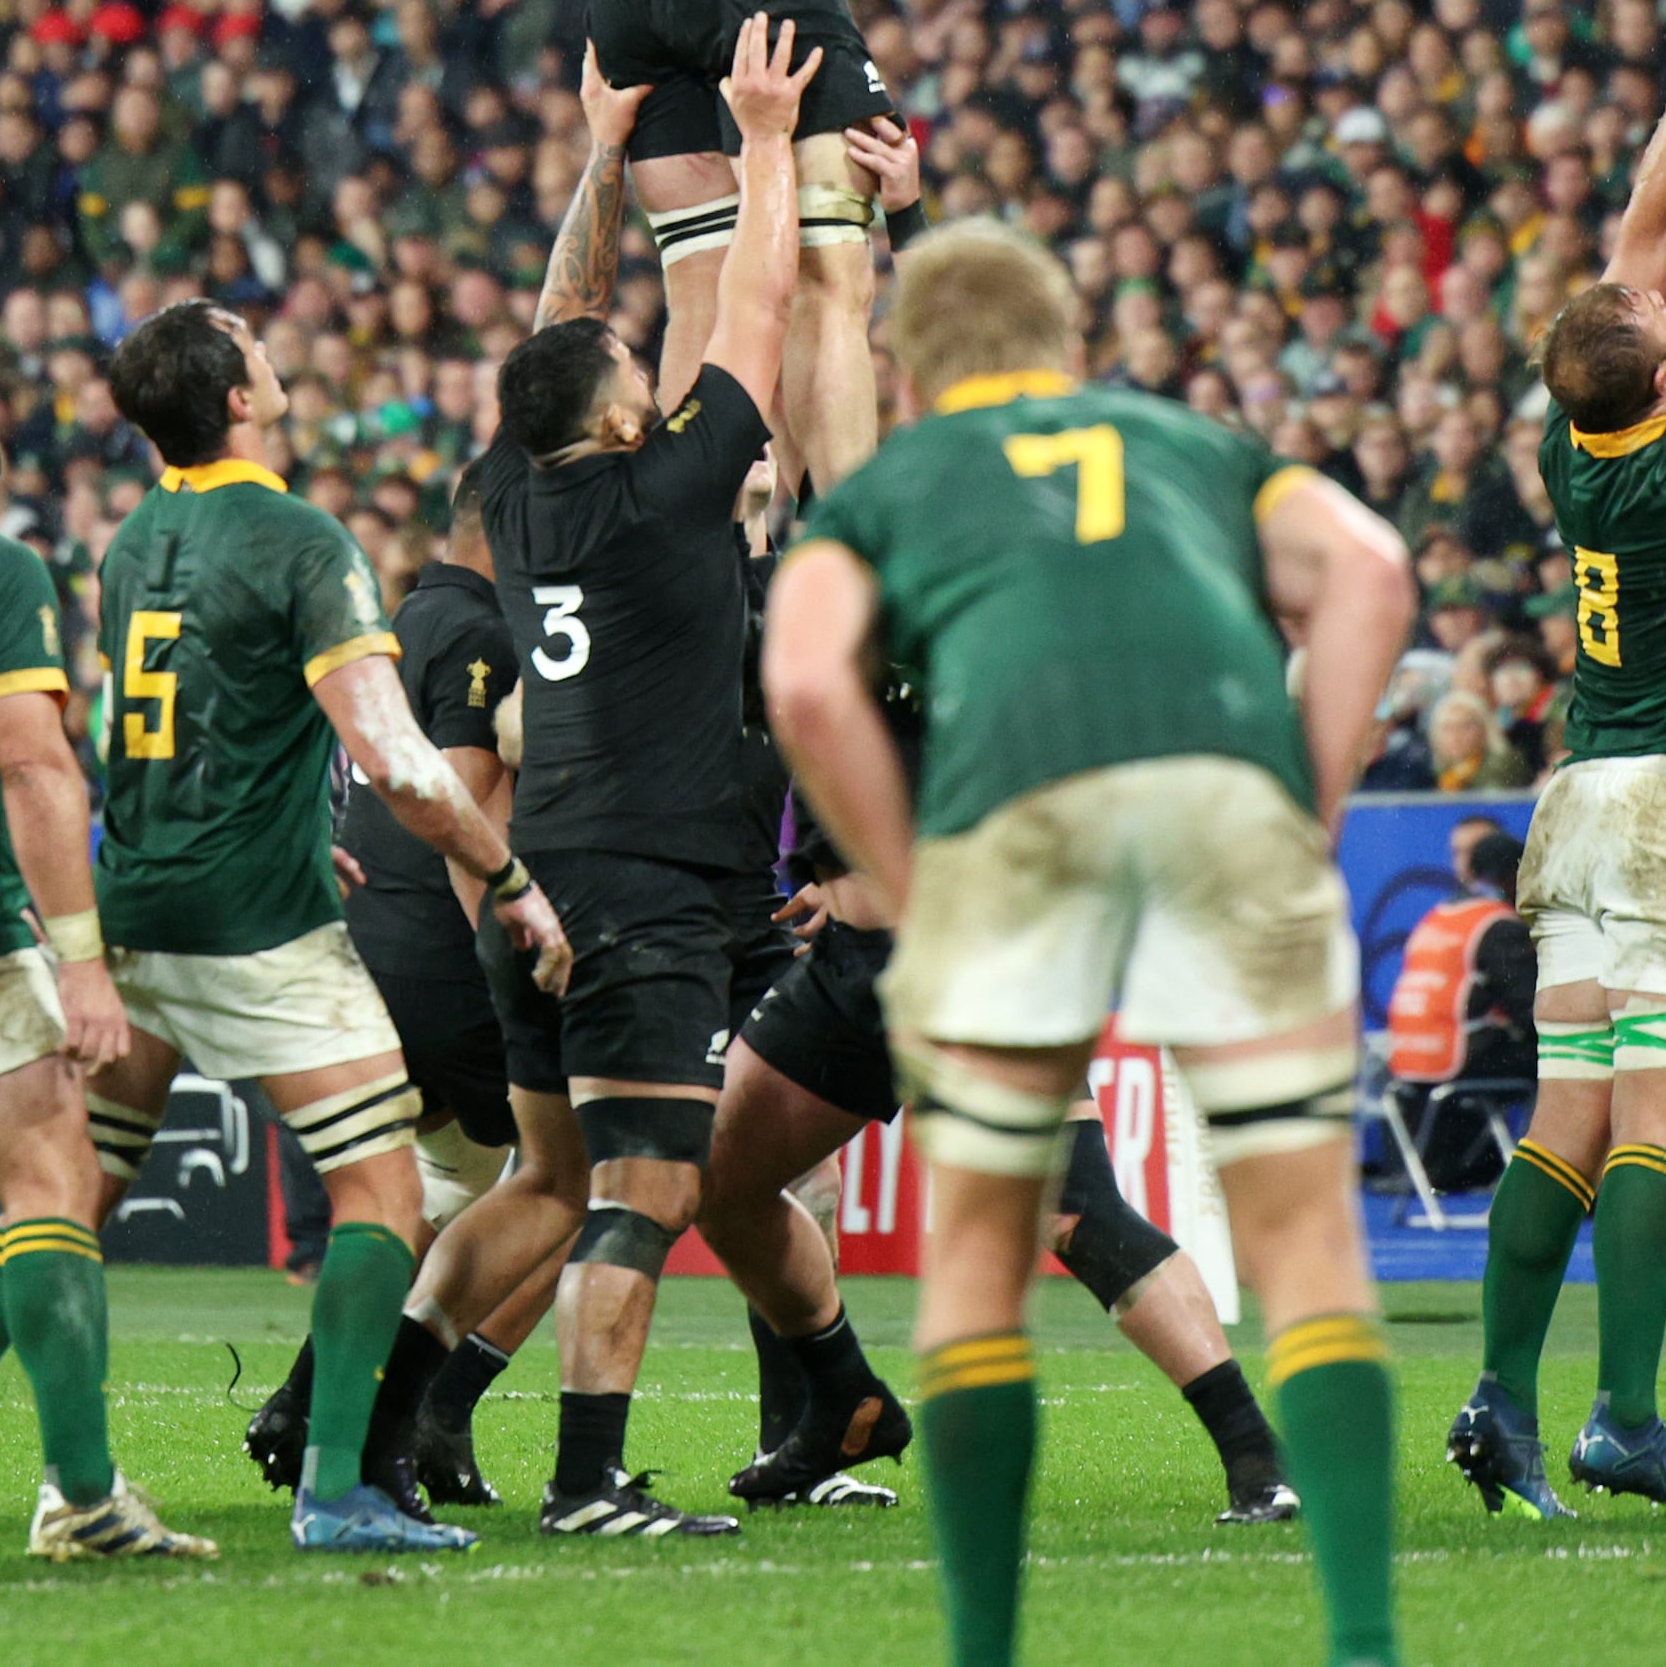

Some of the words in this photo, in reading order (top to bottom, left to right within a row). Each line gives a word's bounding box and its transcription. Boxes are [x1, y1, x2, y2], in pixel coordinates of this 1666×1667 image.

[1003, 422, 1125, 544] 7
[531, 584, 591, 681] 3
[1573, 545, 1623, 668] 8
[123, 610, 183, 760] 5
